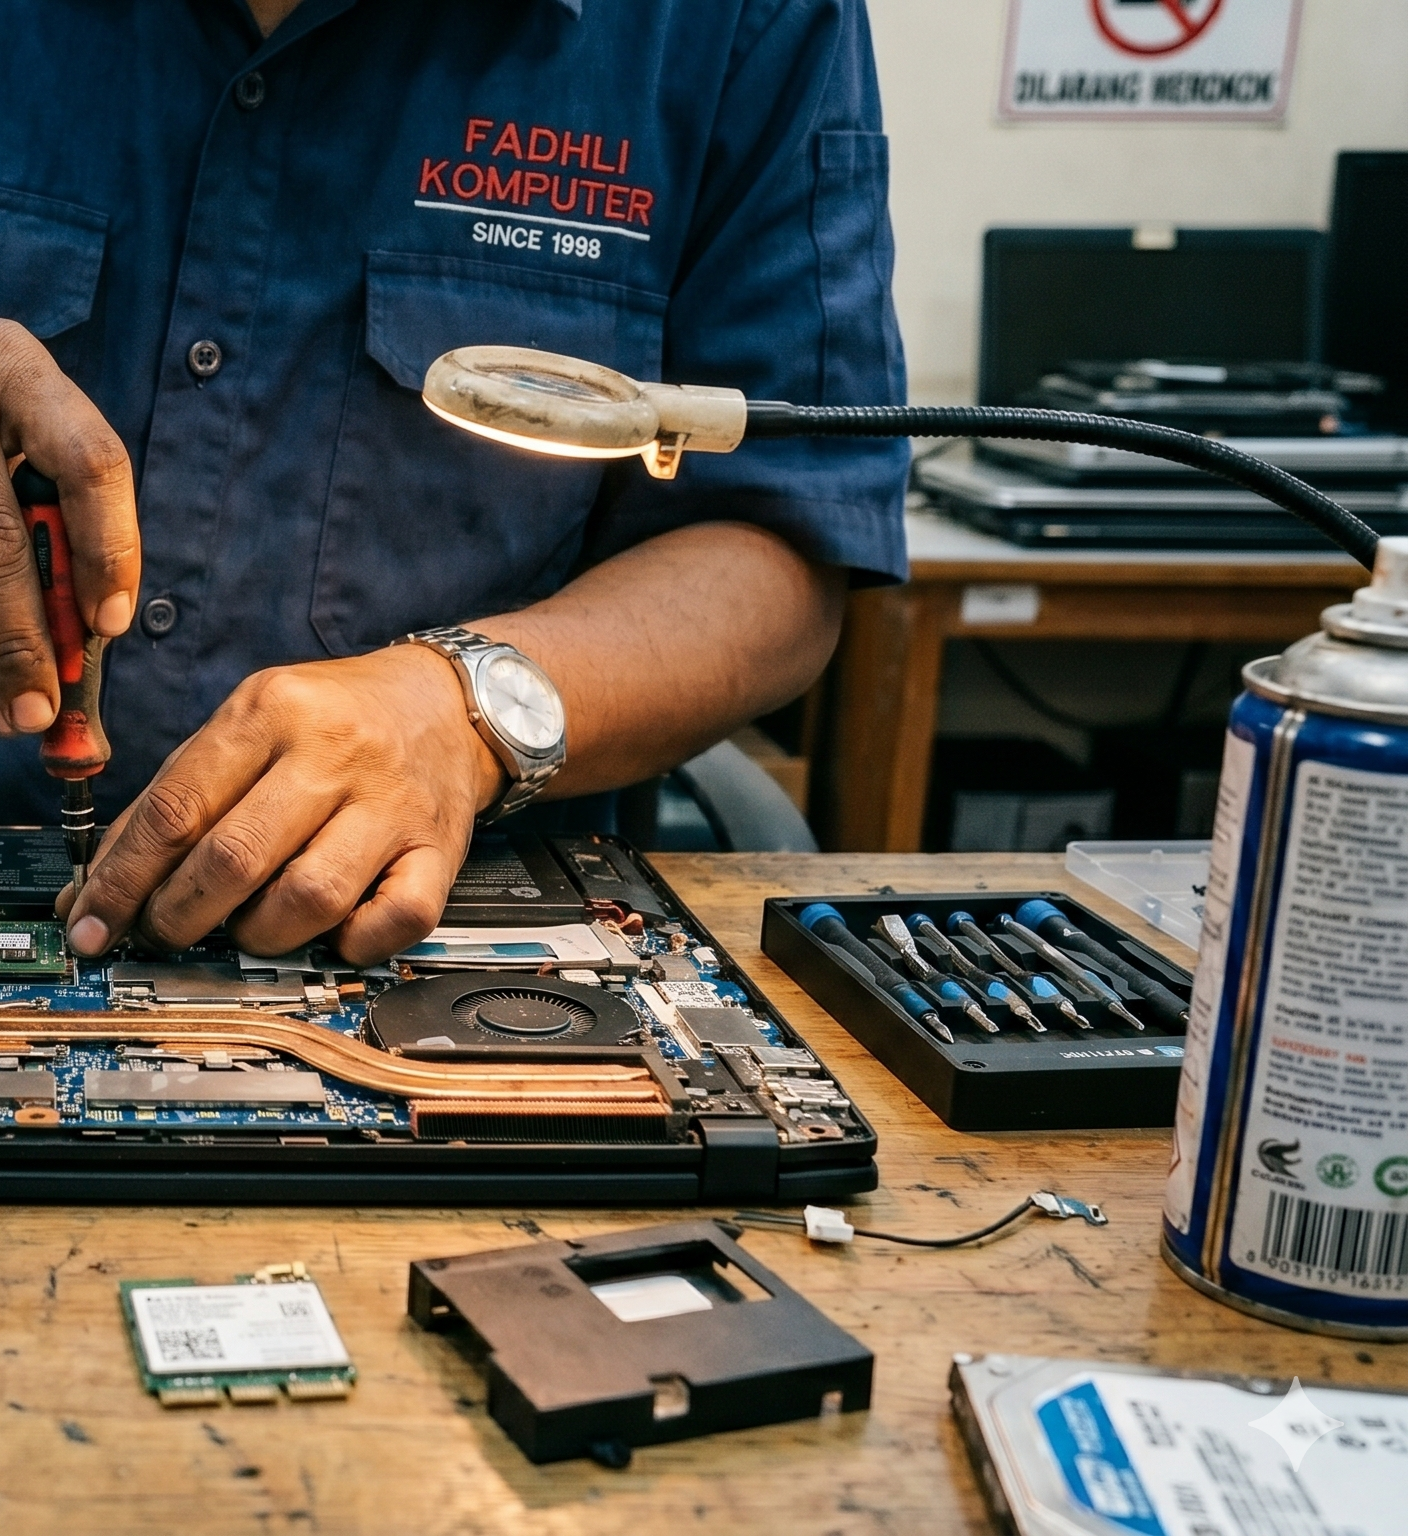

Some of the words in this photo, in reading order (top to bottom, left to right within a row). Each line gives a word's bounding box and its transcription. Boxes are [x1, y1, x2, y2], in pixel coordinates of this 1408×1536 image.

[465, 118, 630, 175] FADHLI
[419, 158, 655, 226] KOMPUTER
[472, 221, 543, 251] SINCE
[552, 231, 602, 260] 1998
